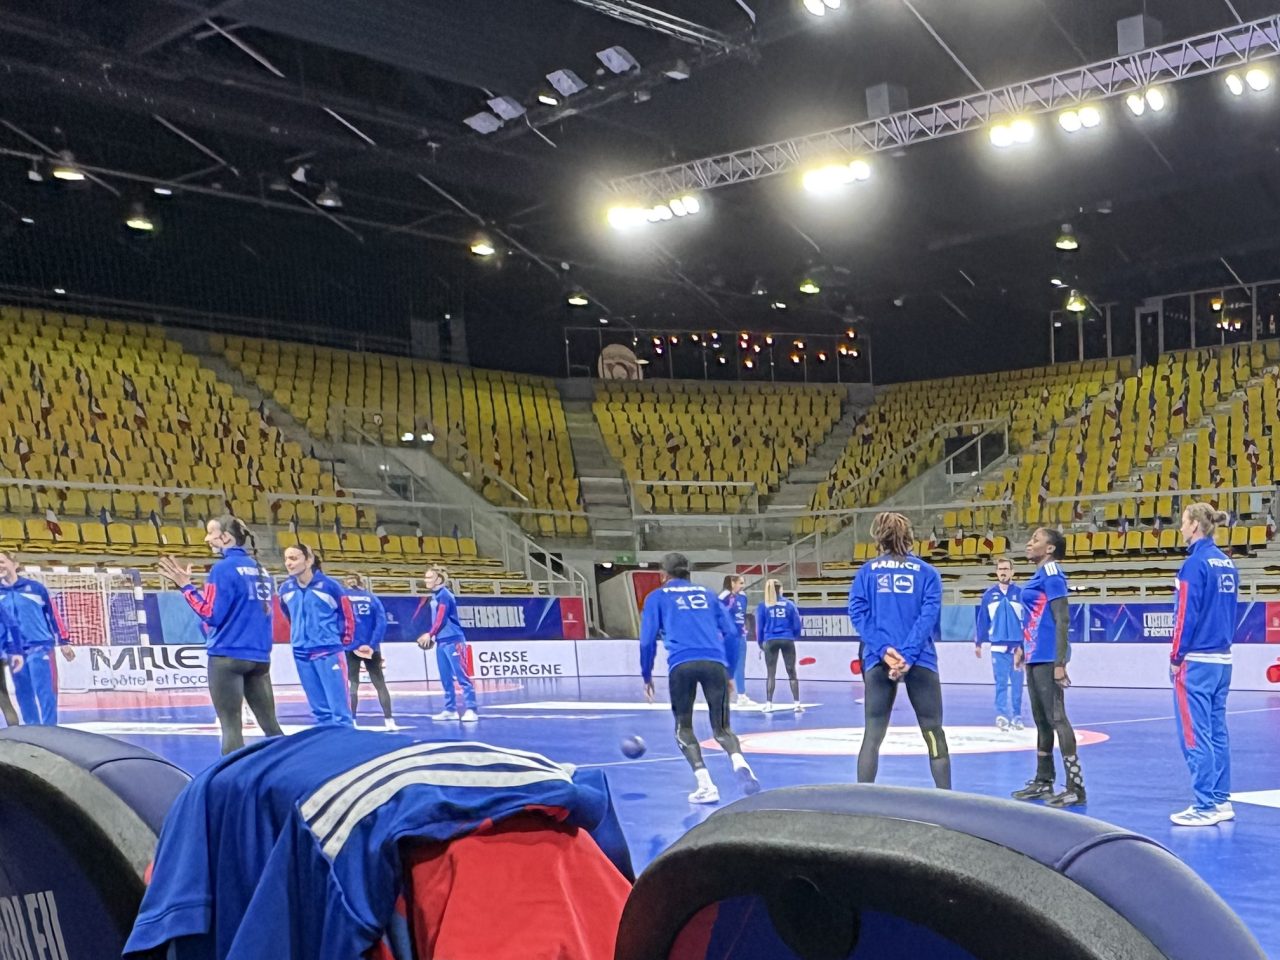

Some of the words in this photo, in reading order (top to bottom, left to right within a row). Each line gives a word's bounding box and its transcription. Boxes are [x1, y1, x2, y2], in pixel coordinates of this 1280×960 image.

[89, 646, 208, 671] MILLE
[479, 650, 528, 663] CAISSE
[480, 663, 563, 677] D'EPARGNE
